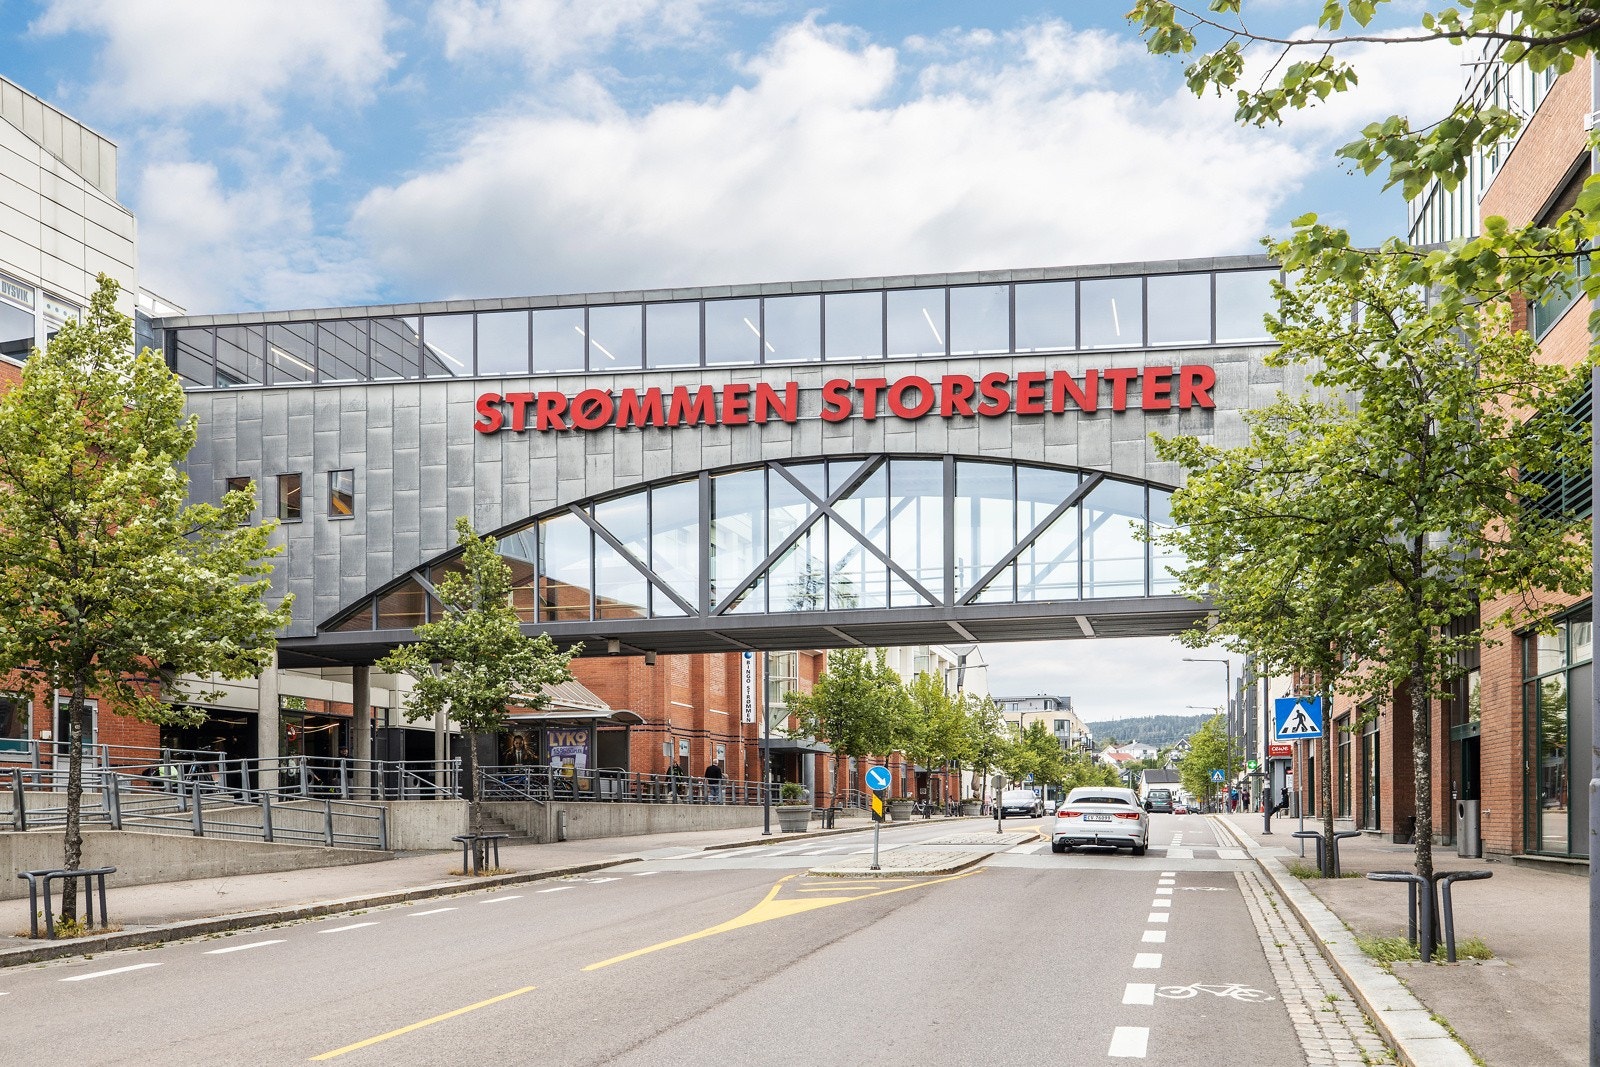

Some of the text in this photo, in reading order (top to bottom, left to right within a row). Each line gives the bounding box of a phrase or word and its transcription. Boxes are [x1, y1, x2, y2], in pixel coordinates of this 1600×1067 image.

[1, 281, 28, 302] DYSVIK
[474, 365, 1216, 434] STRØMMEN STORSENTER
[549, 731, 587, 746] LYKO
